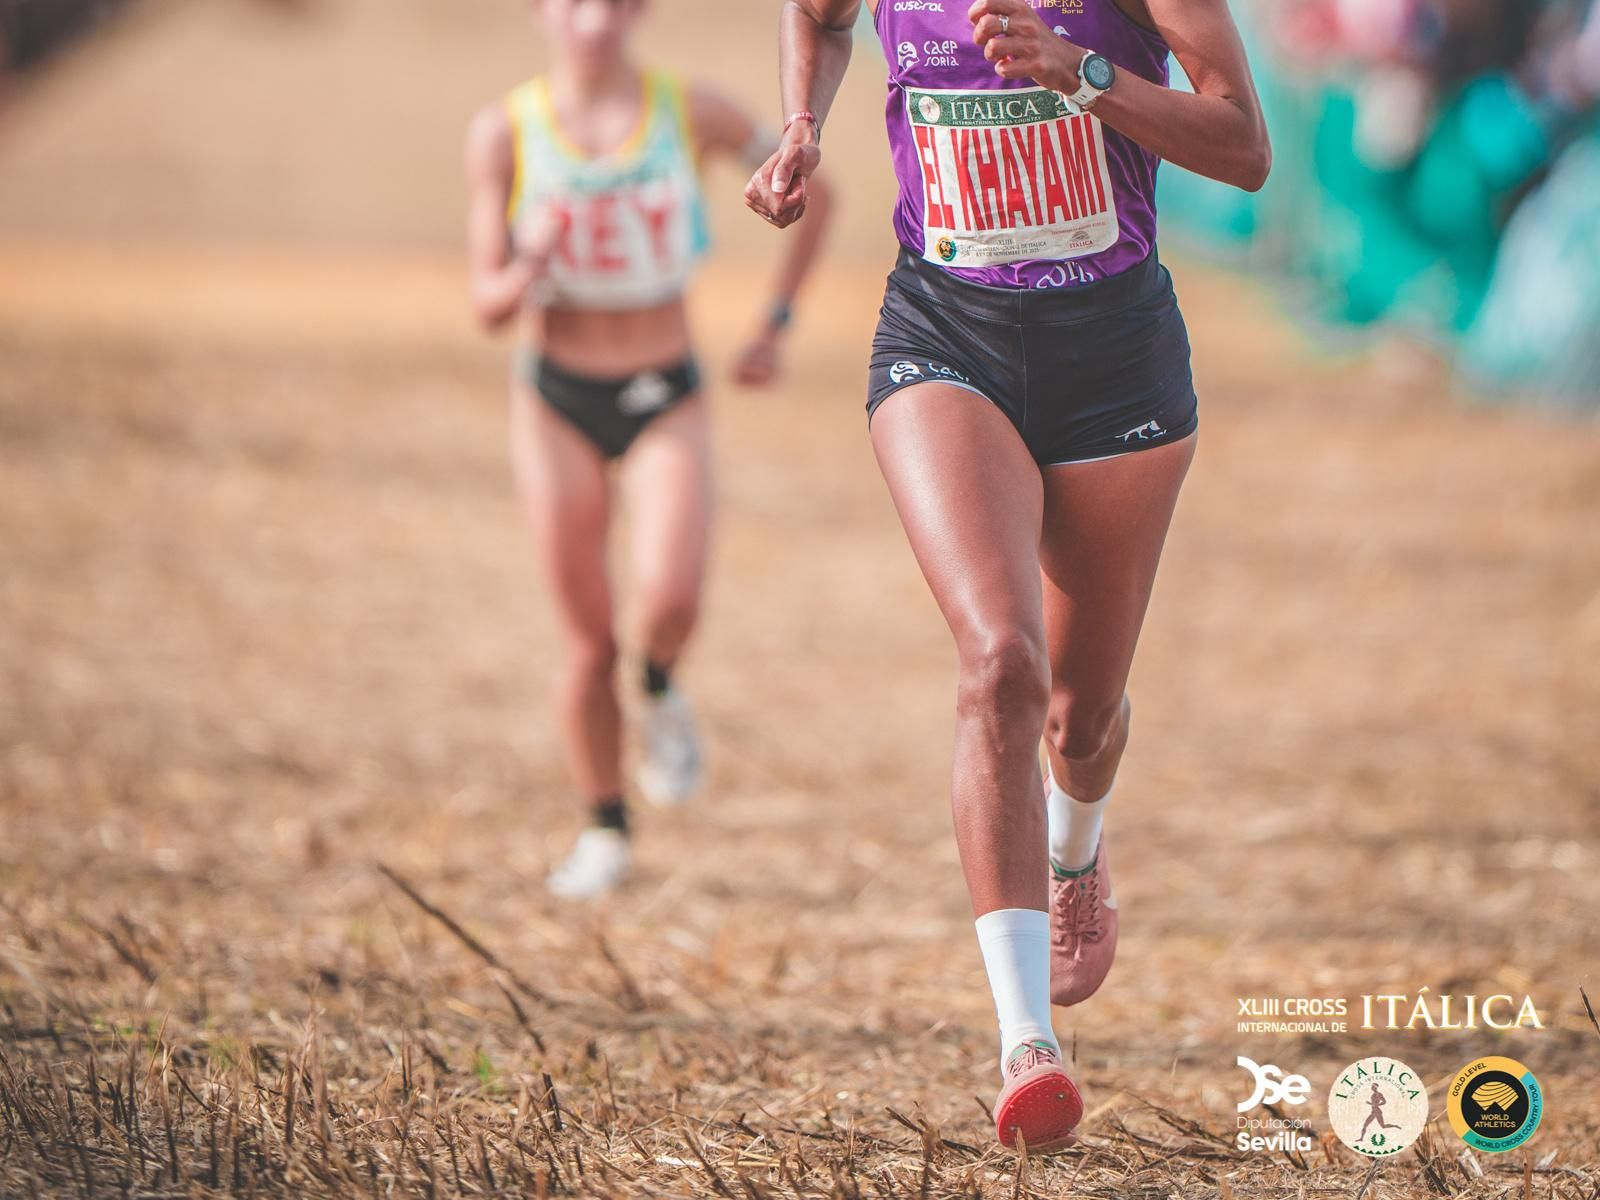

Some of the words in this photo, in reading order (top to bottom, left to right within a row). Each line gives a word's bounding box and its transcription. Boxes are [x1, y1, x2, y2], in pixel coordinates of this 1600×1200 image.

[951, 97, 1040, 120] ITÁLICA
[914, 126, 956, 231] EL
[951, 113, 1107, 231] KHAYAMI
